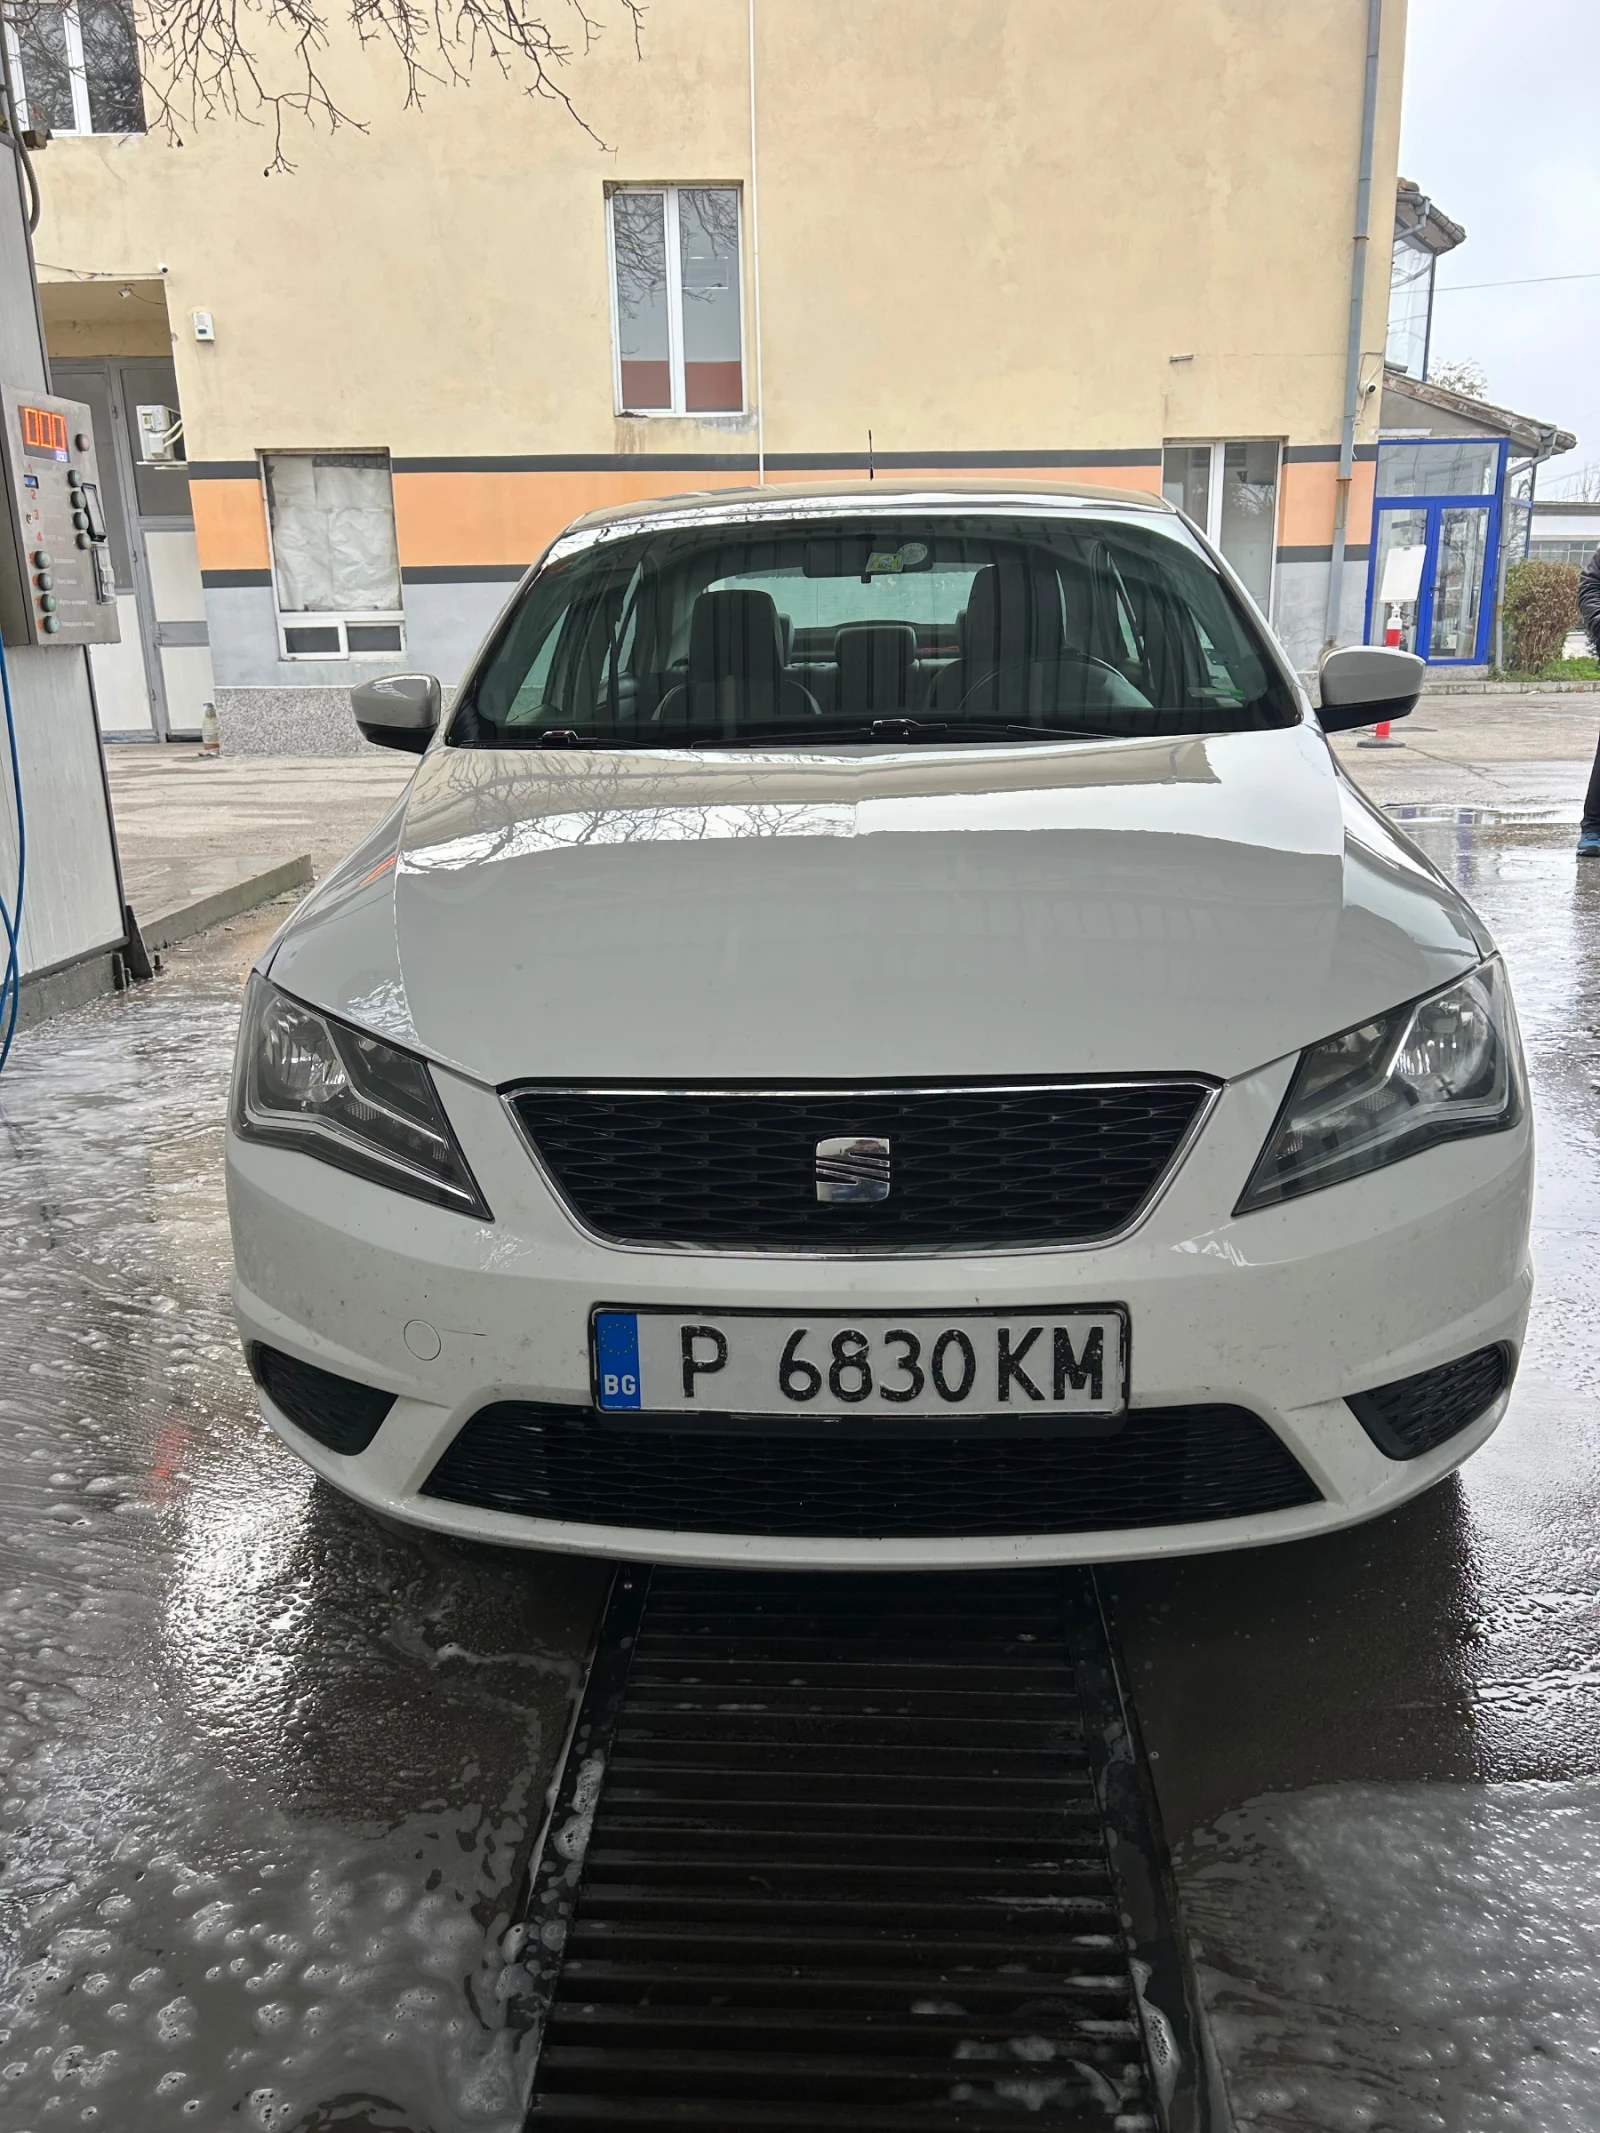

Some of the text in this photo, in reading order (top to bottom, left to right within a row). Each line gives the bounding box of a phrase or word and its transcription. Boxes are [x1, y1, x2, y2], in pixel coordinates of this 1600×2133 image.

[604, 1374, 636, 1396] BG
[680, 1325, 1104, 1403] P 6830 KM
